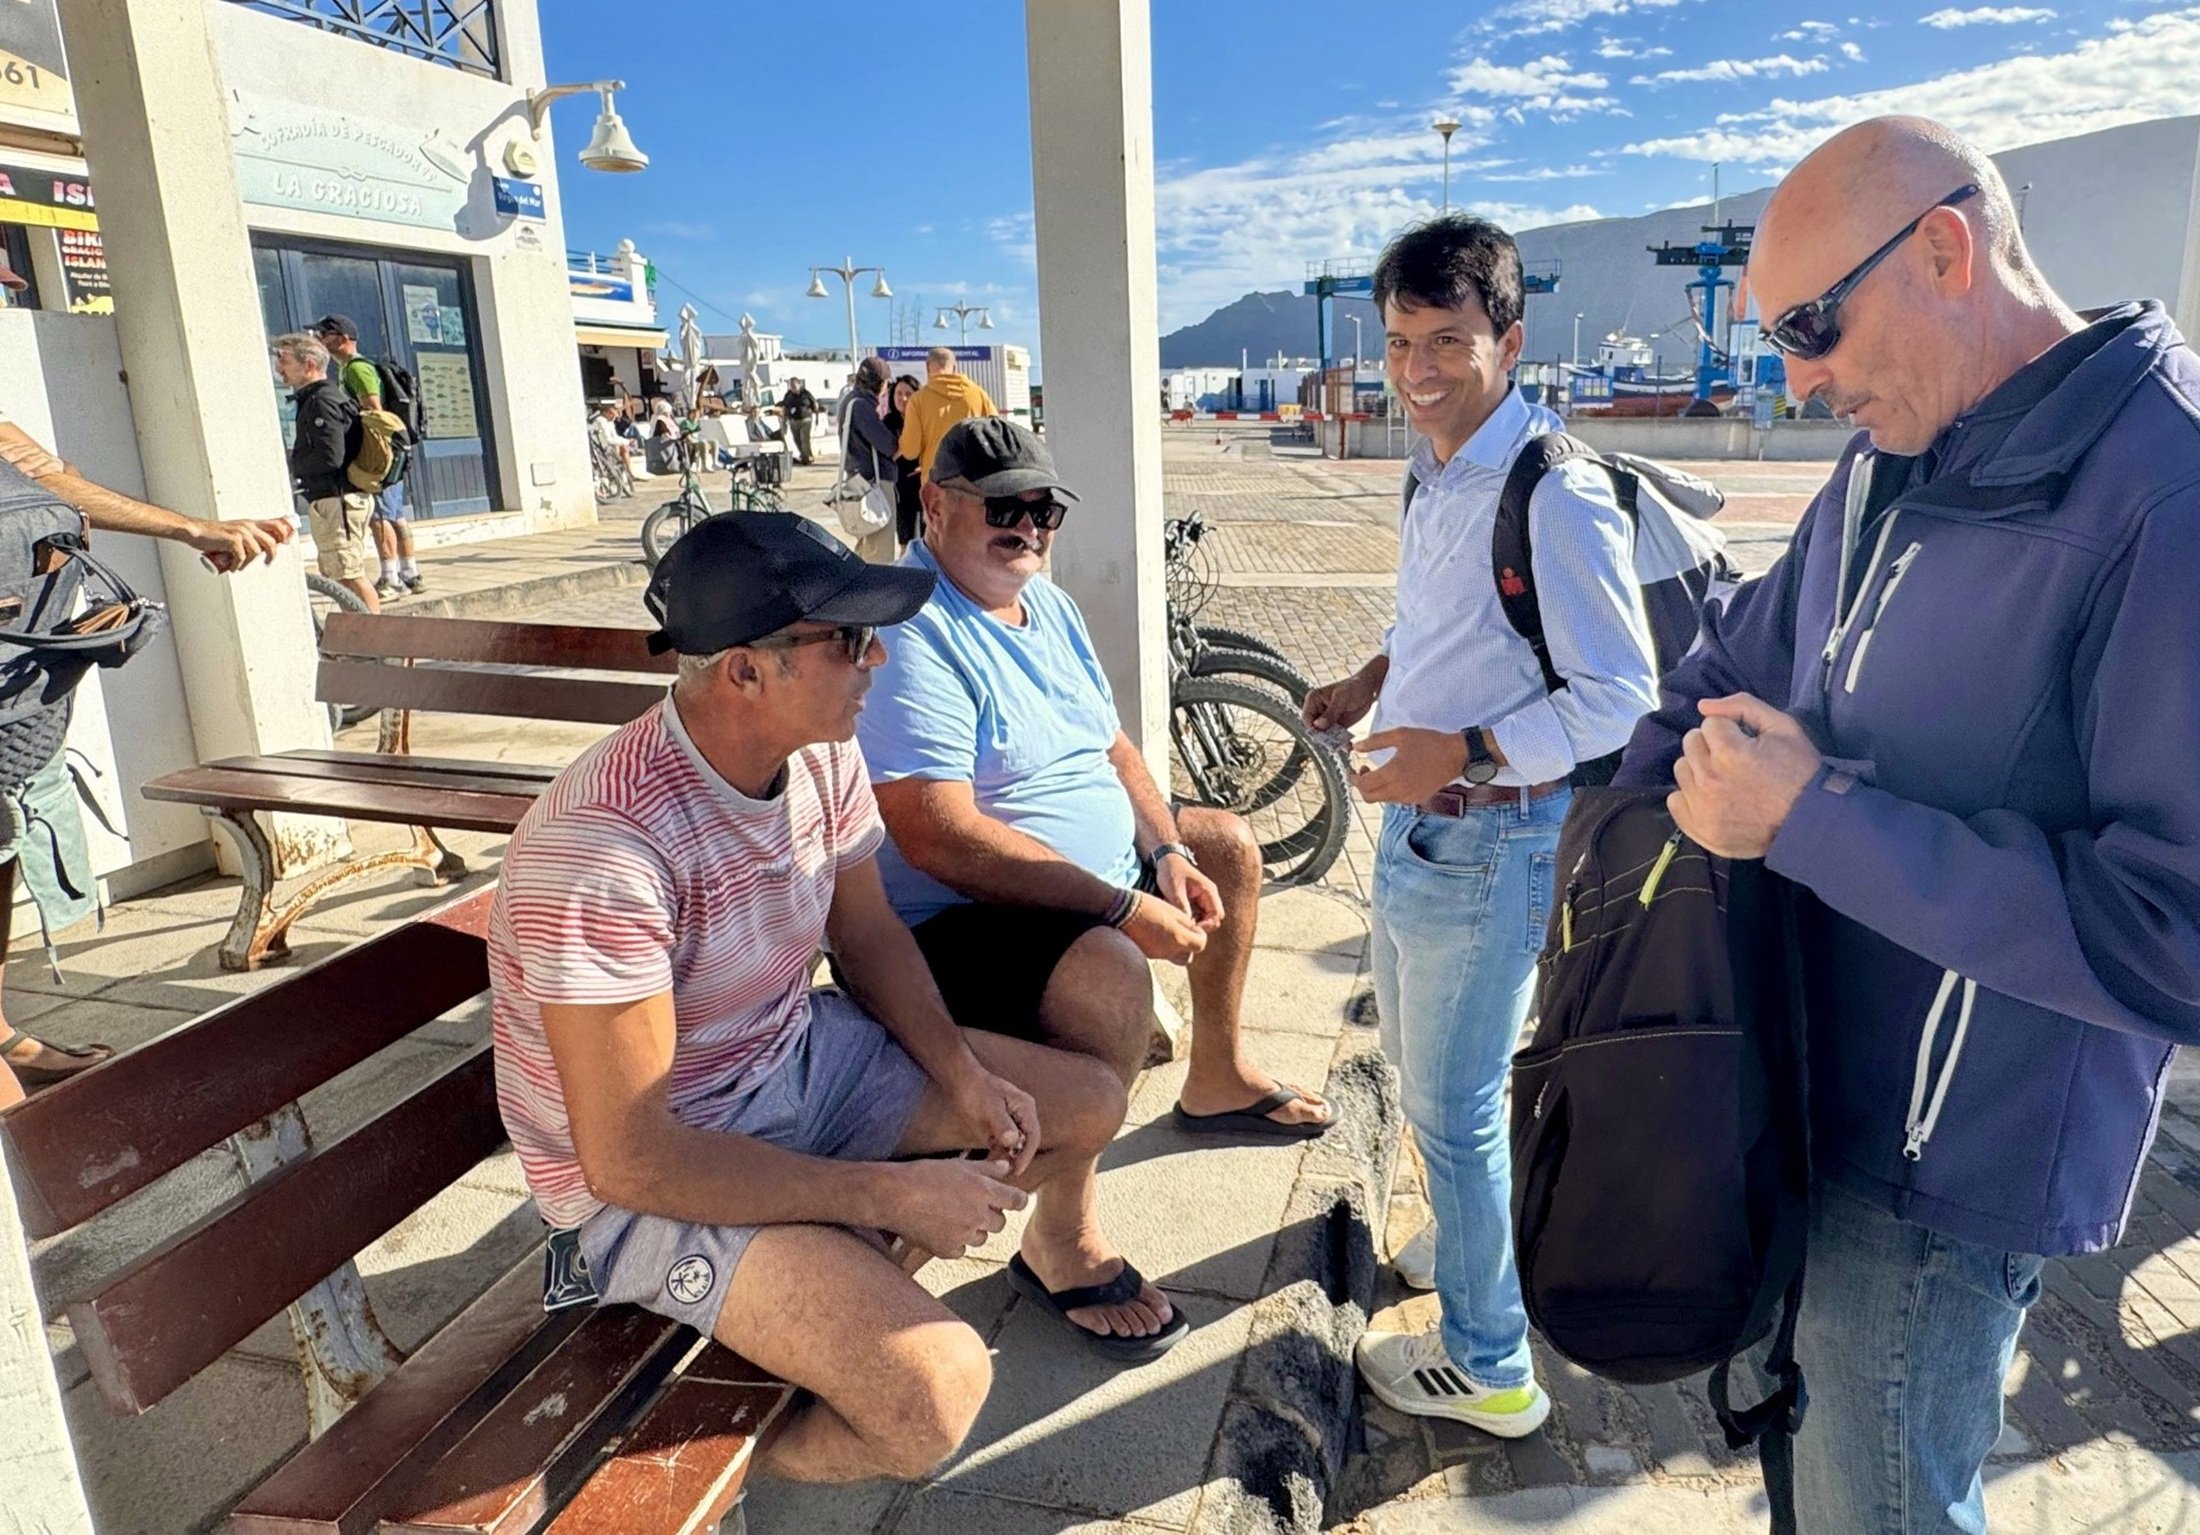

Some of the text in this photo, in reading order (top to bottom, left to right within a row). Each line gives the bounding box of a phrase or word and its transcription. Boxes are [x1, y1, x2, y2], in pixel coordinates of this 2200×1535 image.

[0, 61, 40, 89] 61
[273, 172, 424, 217] LA GRACIOSA
[63, 230, 103, 248] BIK
